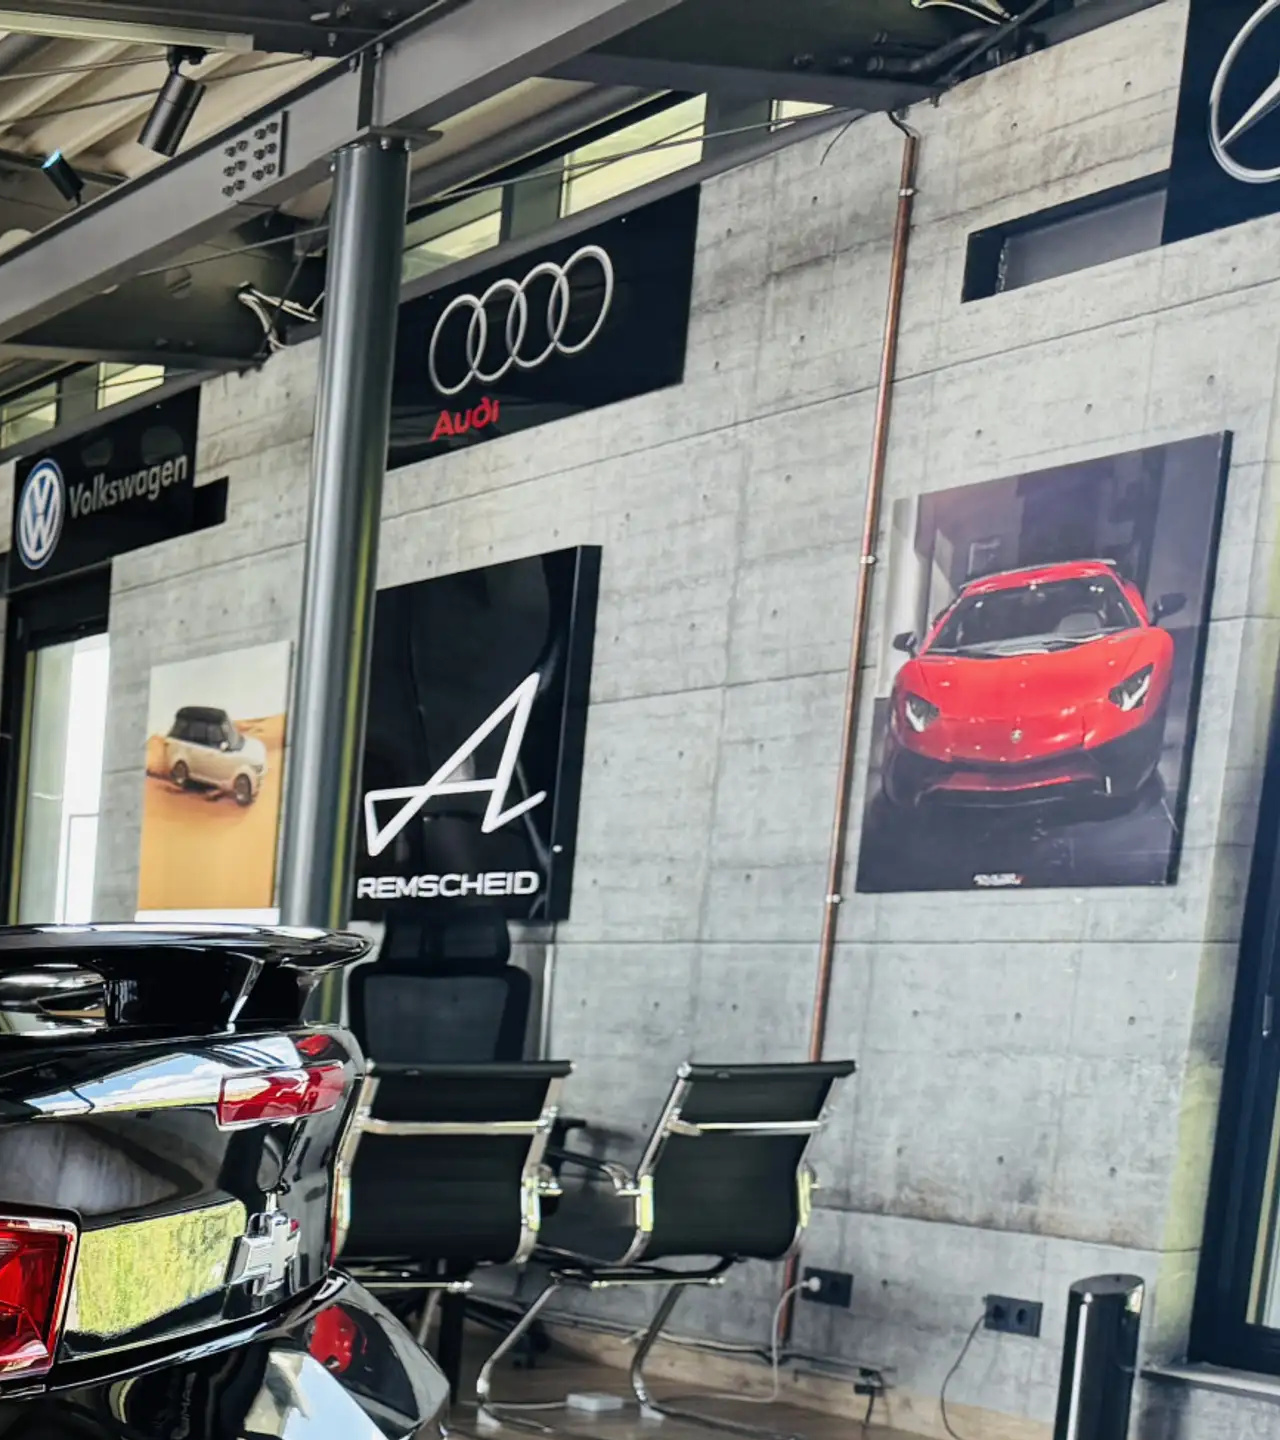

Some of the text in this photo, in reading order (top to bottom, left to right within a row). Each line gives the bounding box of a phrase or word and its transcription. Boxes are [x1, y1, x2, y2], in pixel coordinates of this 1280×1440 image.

[429, 396, 500, 442] Audi
[69, 455, 188, 518] Volkswagen
[357, 870, 540, 899] REMSCHEID
